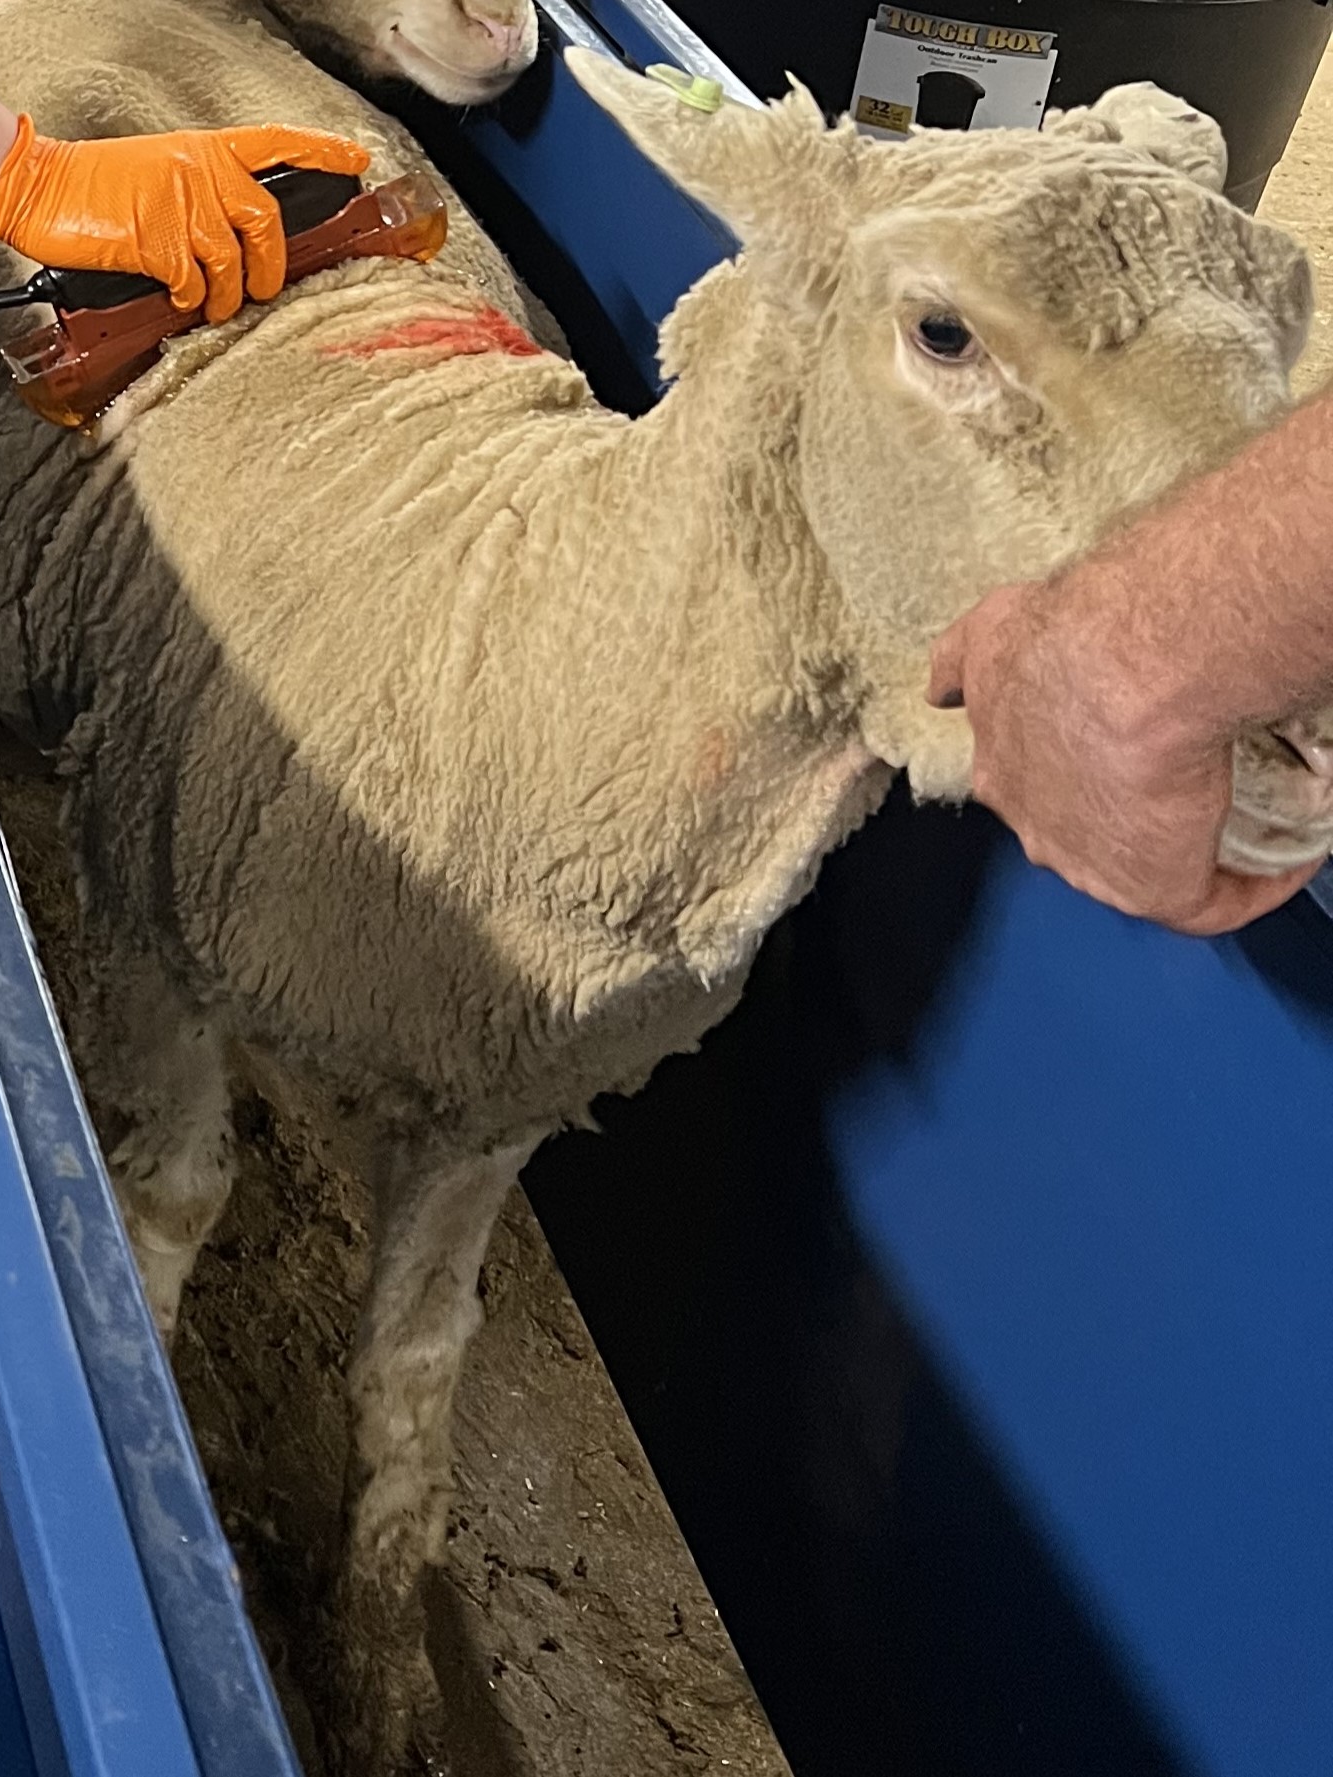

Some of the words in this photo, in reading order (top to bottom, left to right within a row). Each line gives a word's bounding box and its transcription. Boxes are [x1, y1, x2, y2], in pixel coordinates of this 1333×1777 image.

[886, 10, 980, 46] TOUGH
[984, 26, 1047, 54] BOX
[917, 44, 955, 57] Outdoor
[868, 98, 890, 114] 32
